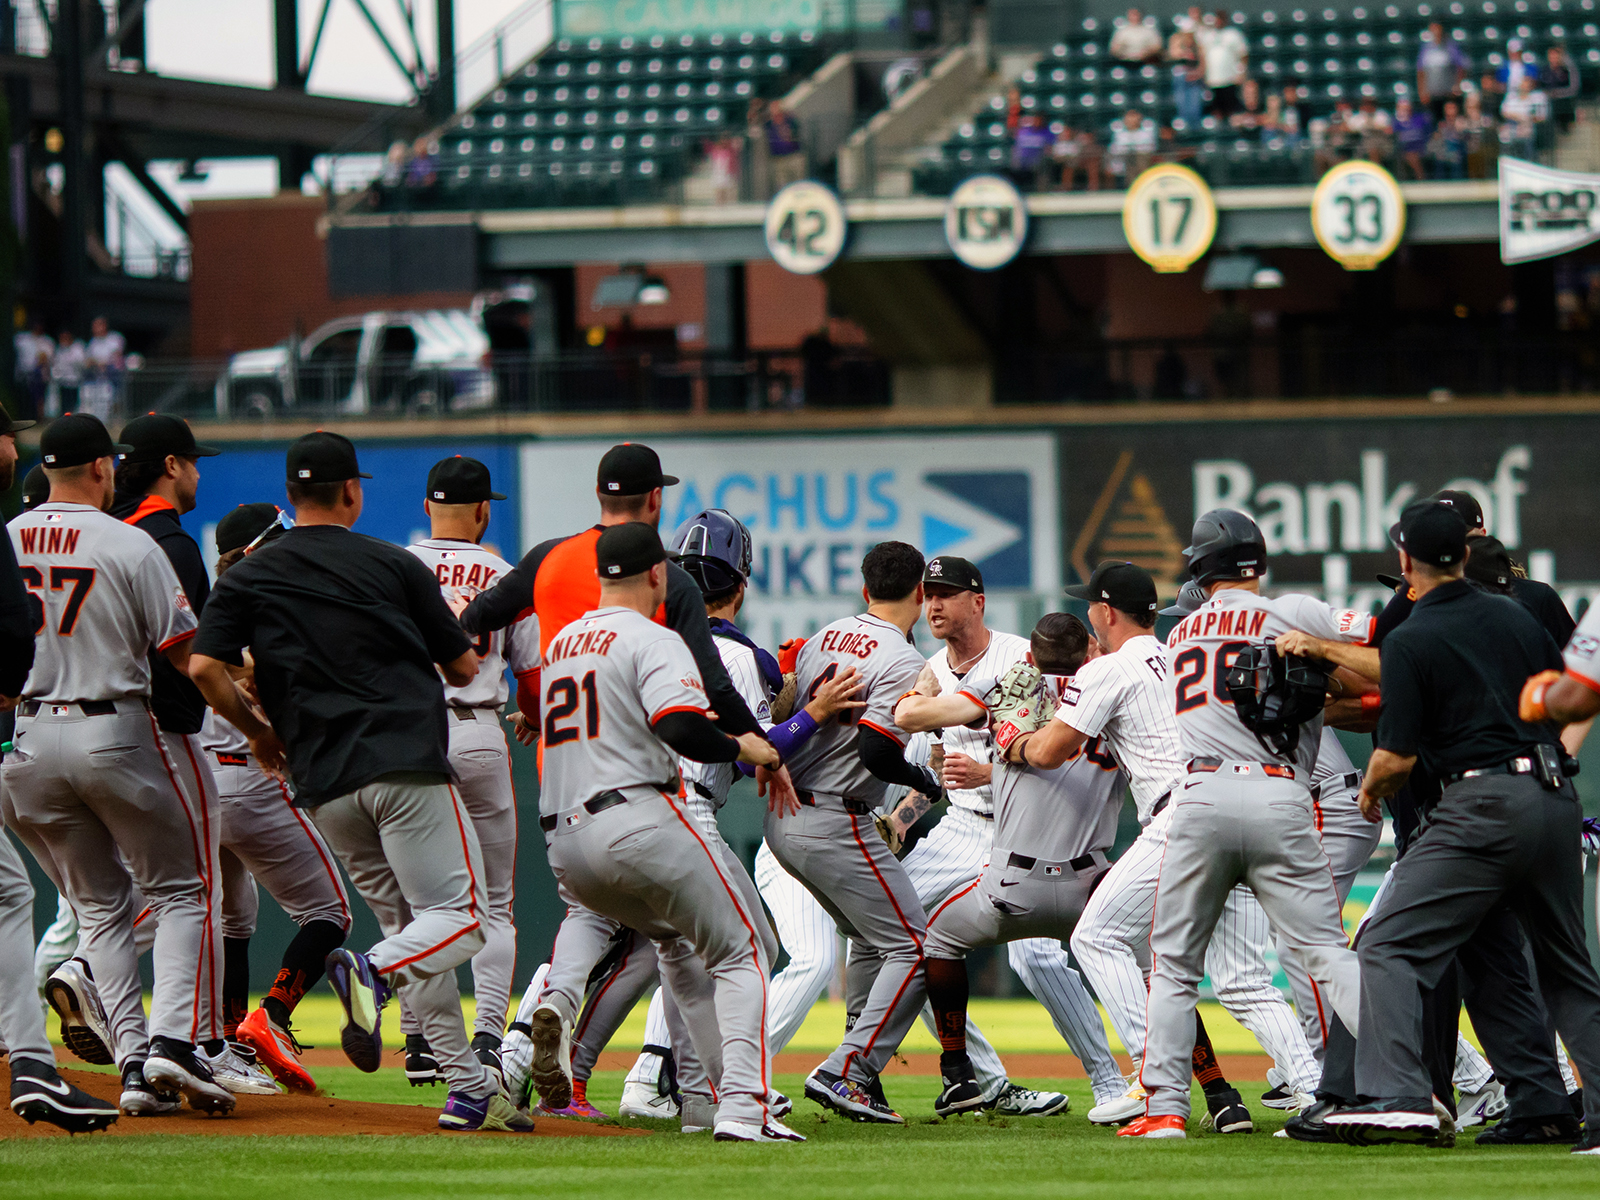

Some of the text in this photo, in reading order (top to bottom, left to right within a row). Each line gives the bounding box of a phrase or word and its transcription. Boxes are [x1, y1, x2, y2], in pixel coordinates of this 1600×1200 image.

[777, 210, 827, 256] 42
[1149, 196, 1193, 246] 17
[1333, 195, 1383, 243] 33
[659, 470, 900, 533] ACHUS
[1192, 450, 1417, 557] Bank
[20, 527, 81, 555] WINN
[436, 563, 497, 590] CRAY
[820, 630, 878, 660] FLORES
[1169, 609, 1268, 649] CHAPMAN
[544, 669, 600, 749] 21
